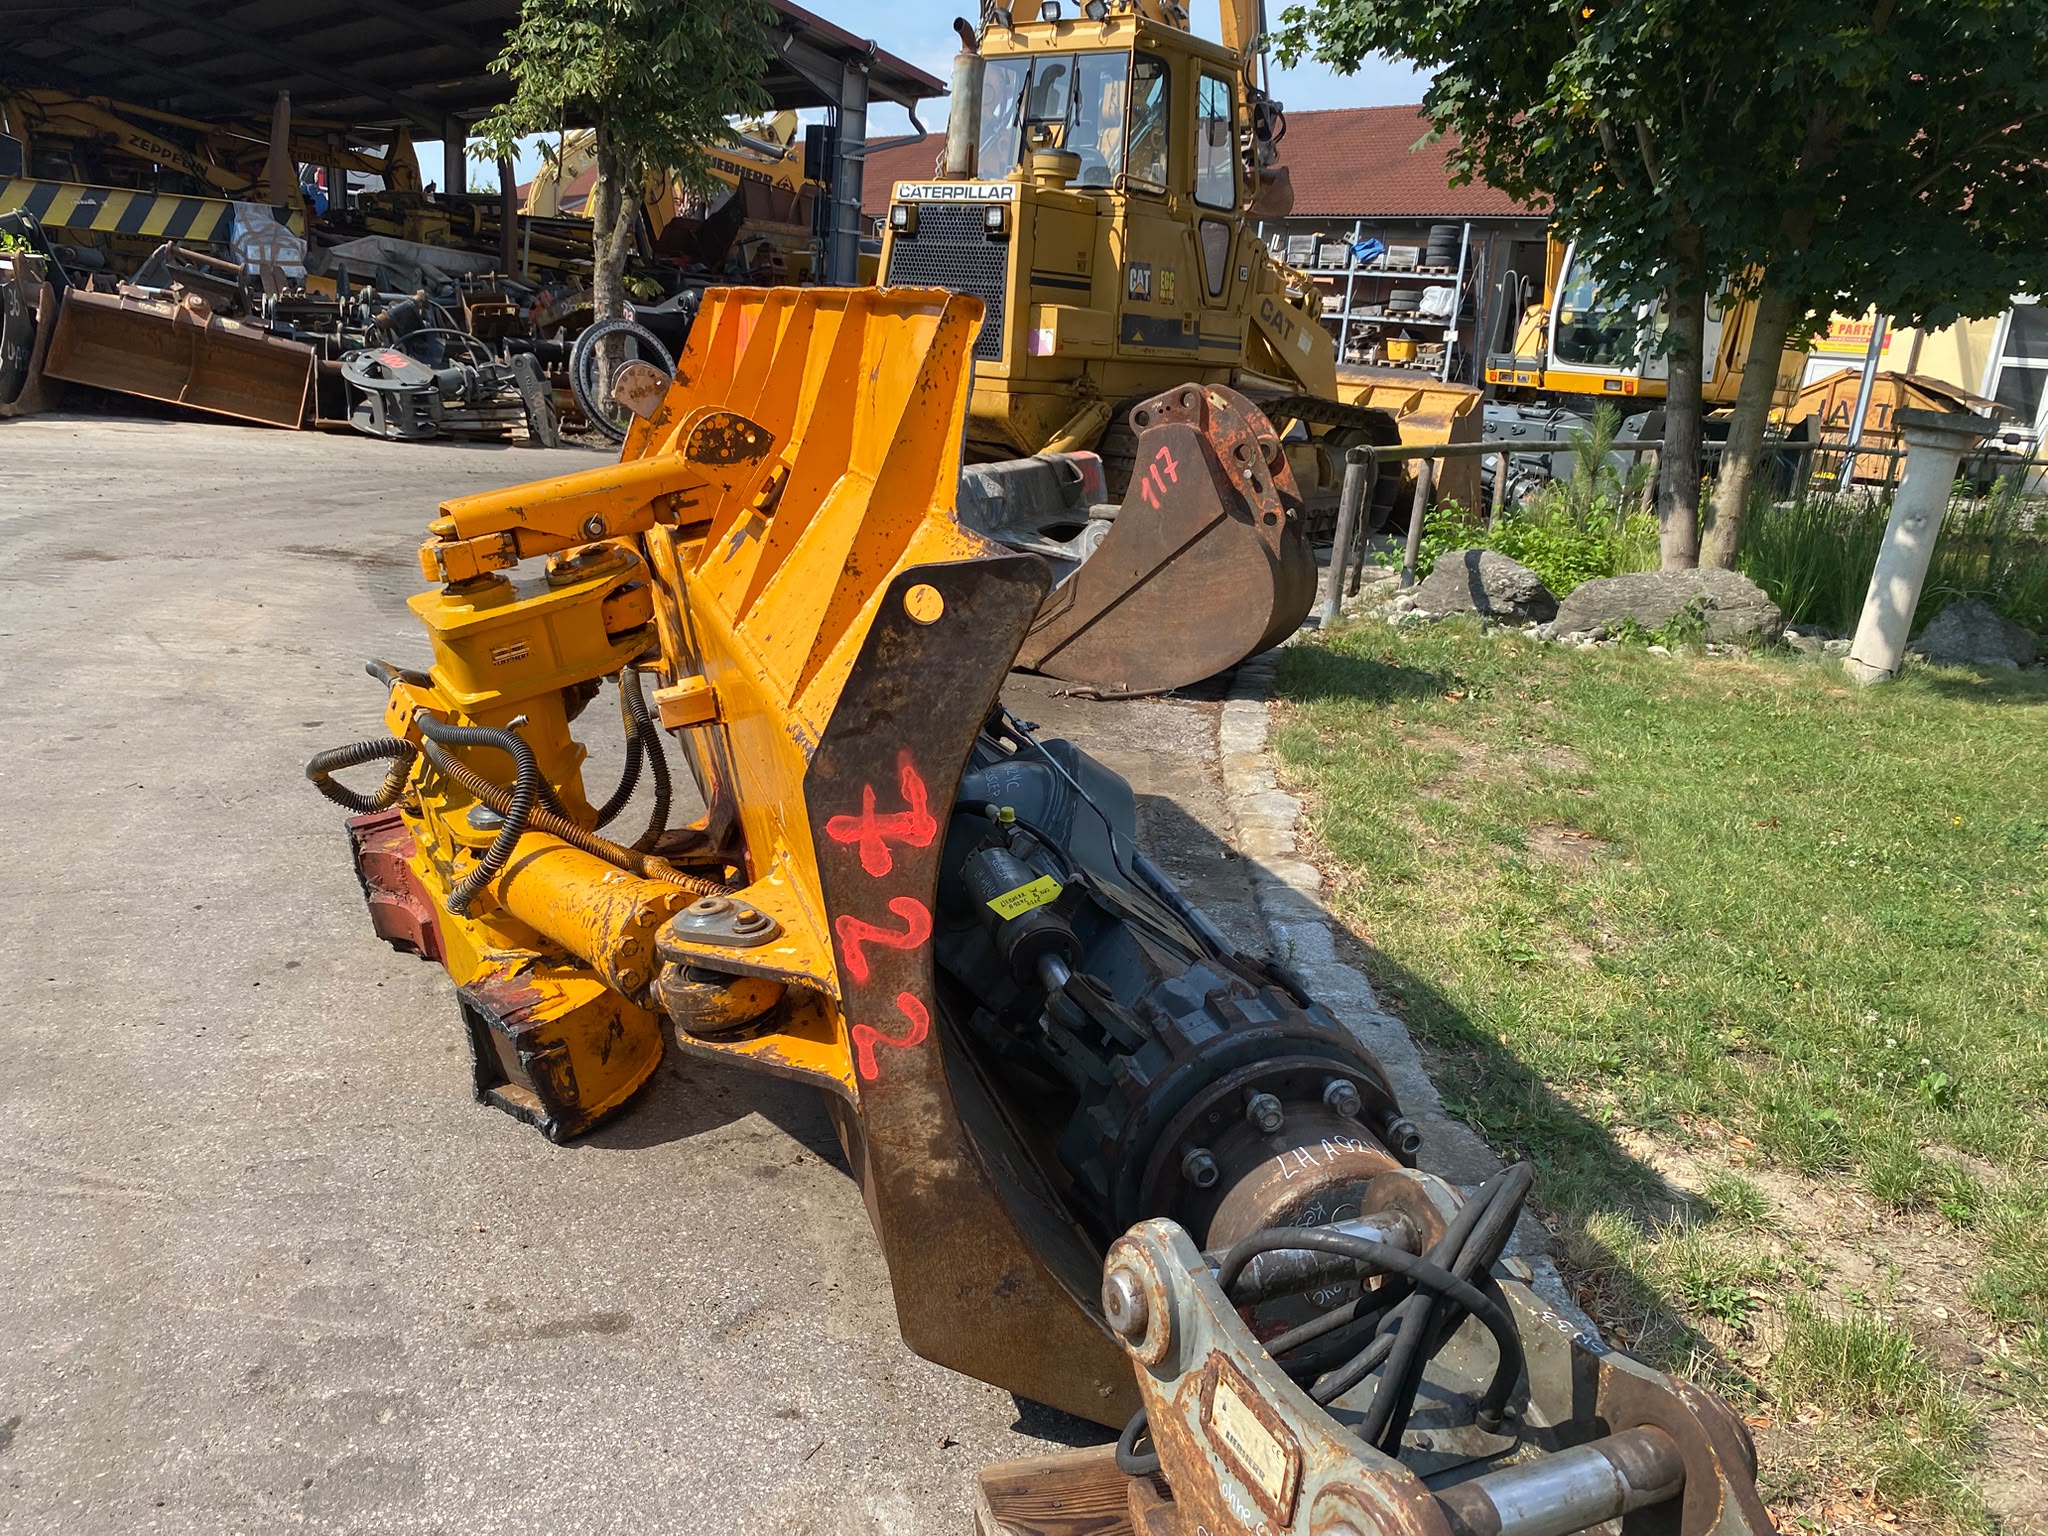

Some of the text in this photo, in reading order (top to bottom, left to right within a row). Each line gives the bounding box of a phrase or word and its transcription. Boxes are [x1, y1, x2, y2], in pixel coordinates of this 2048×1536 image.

[900, 185, 1013, 199] CATERPILLAR
[1129, 268, 1151, 294] CAT
[1260, 297, 1295, 341] CAT
[1838, 323, 1874, 336] PARTS
[1141, 446, 1178, 510] 117
[824, 764, 938, 1080] 722
[1275, 1145, 1321, 1180] LH
